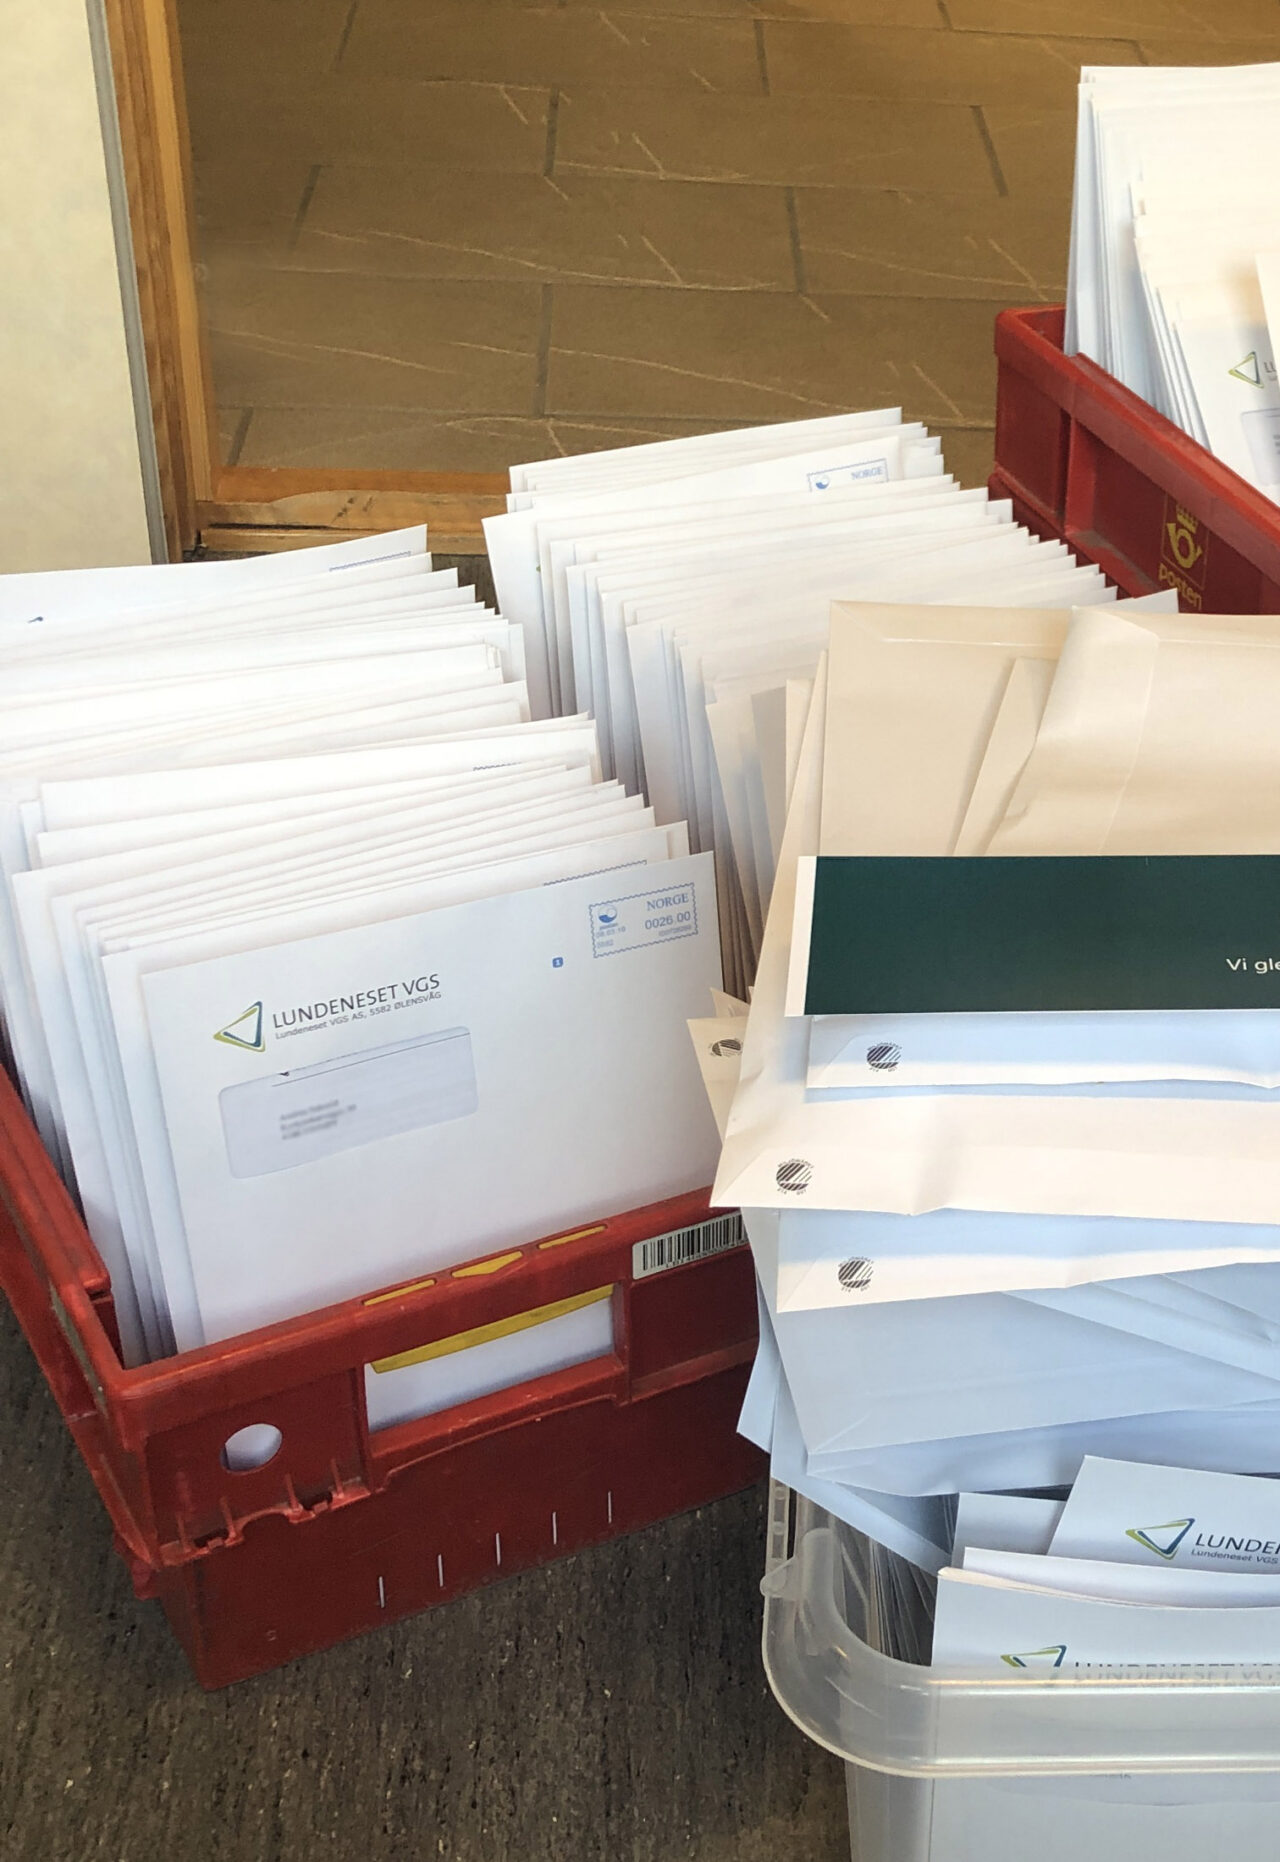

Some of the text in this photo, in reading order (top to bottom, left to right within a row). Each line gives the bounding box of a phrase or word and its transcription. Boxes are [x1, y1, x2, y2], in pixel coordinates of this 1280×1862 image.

[646, 893, 690, 911] NORGE
[1225, 957, 1248, 971] Vi
[272, 974, 440, 1028] LUNDENESET VGS
[275, 1021, 328, 1040] Lundeneset
[329, 1015, 349, 1026] VGS
[369, 1004, 391, 1016] 5582
[1191, 1549, 1252, 1562] Lundeneset
[1256, 1556, 1279, 1565] VGS
